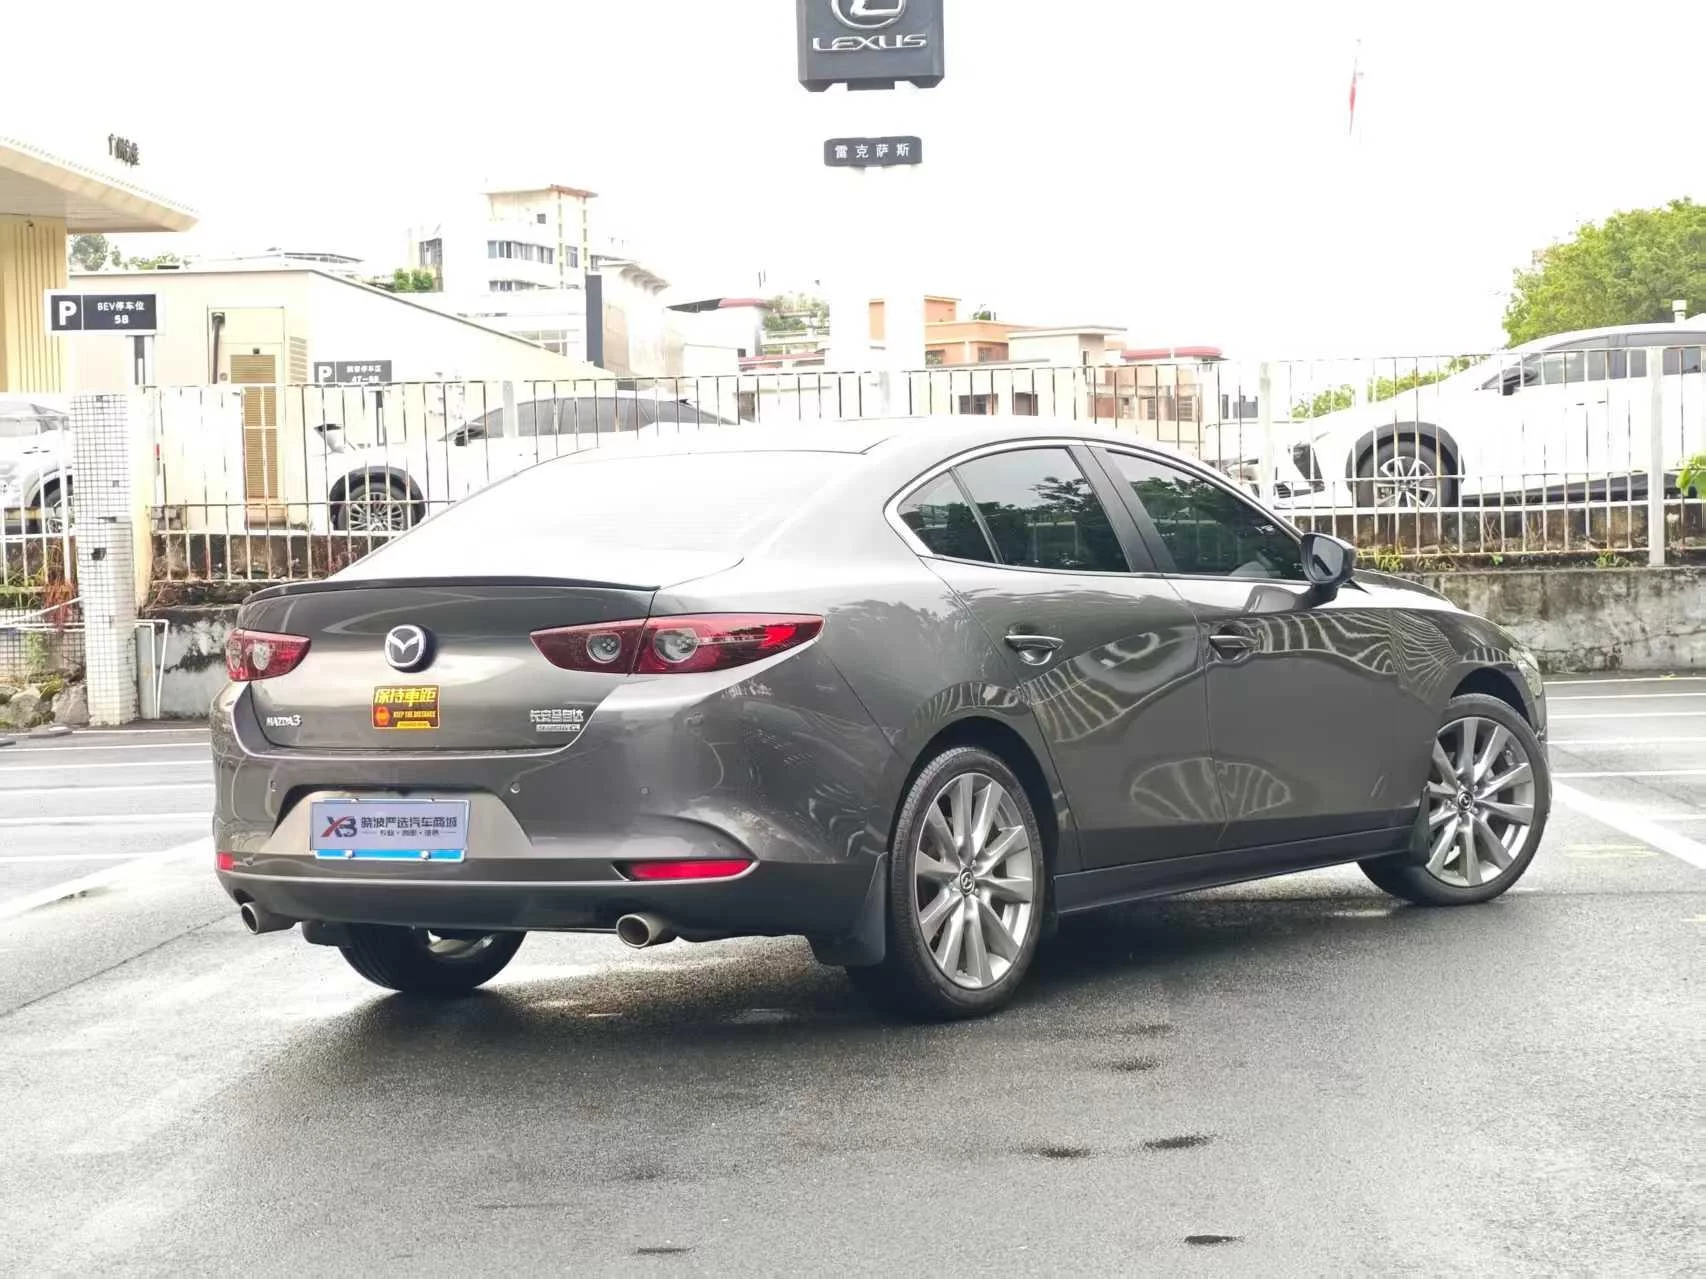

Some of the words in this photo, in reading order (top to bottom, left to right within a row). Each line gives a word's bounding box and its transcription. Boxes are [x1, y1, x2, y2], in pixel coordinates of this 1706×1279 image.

[812, 33, 930, 51] LEXUS
[834, 143, 910, 159] 雷克萨斯
[58, 300, 77, 326] P
[97, 300, 145, 311] BEV停车位
[318, 365, 333, 384] P
[374, 687, 437, 707] 保持車距
